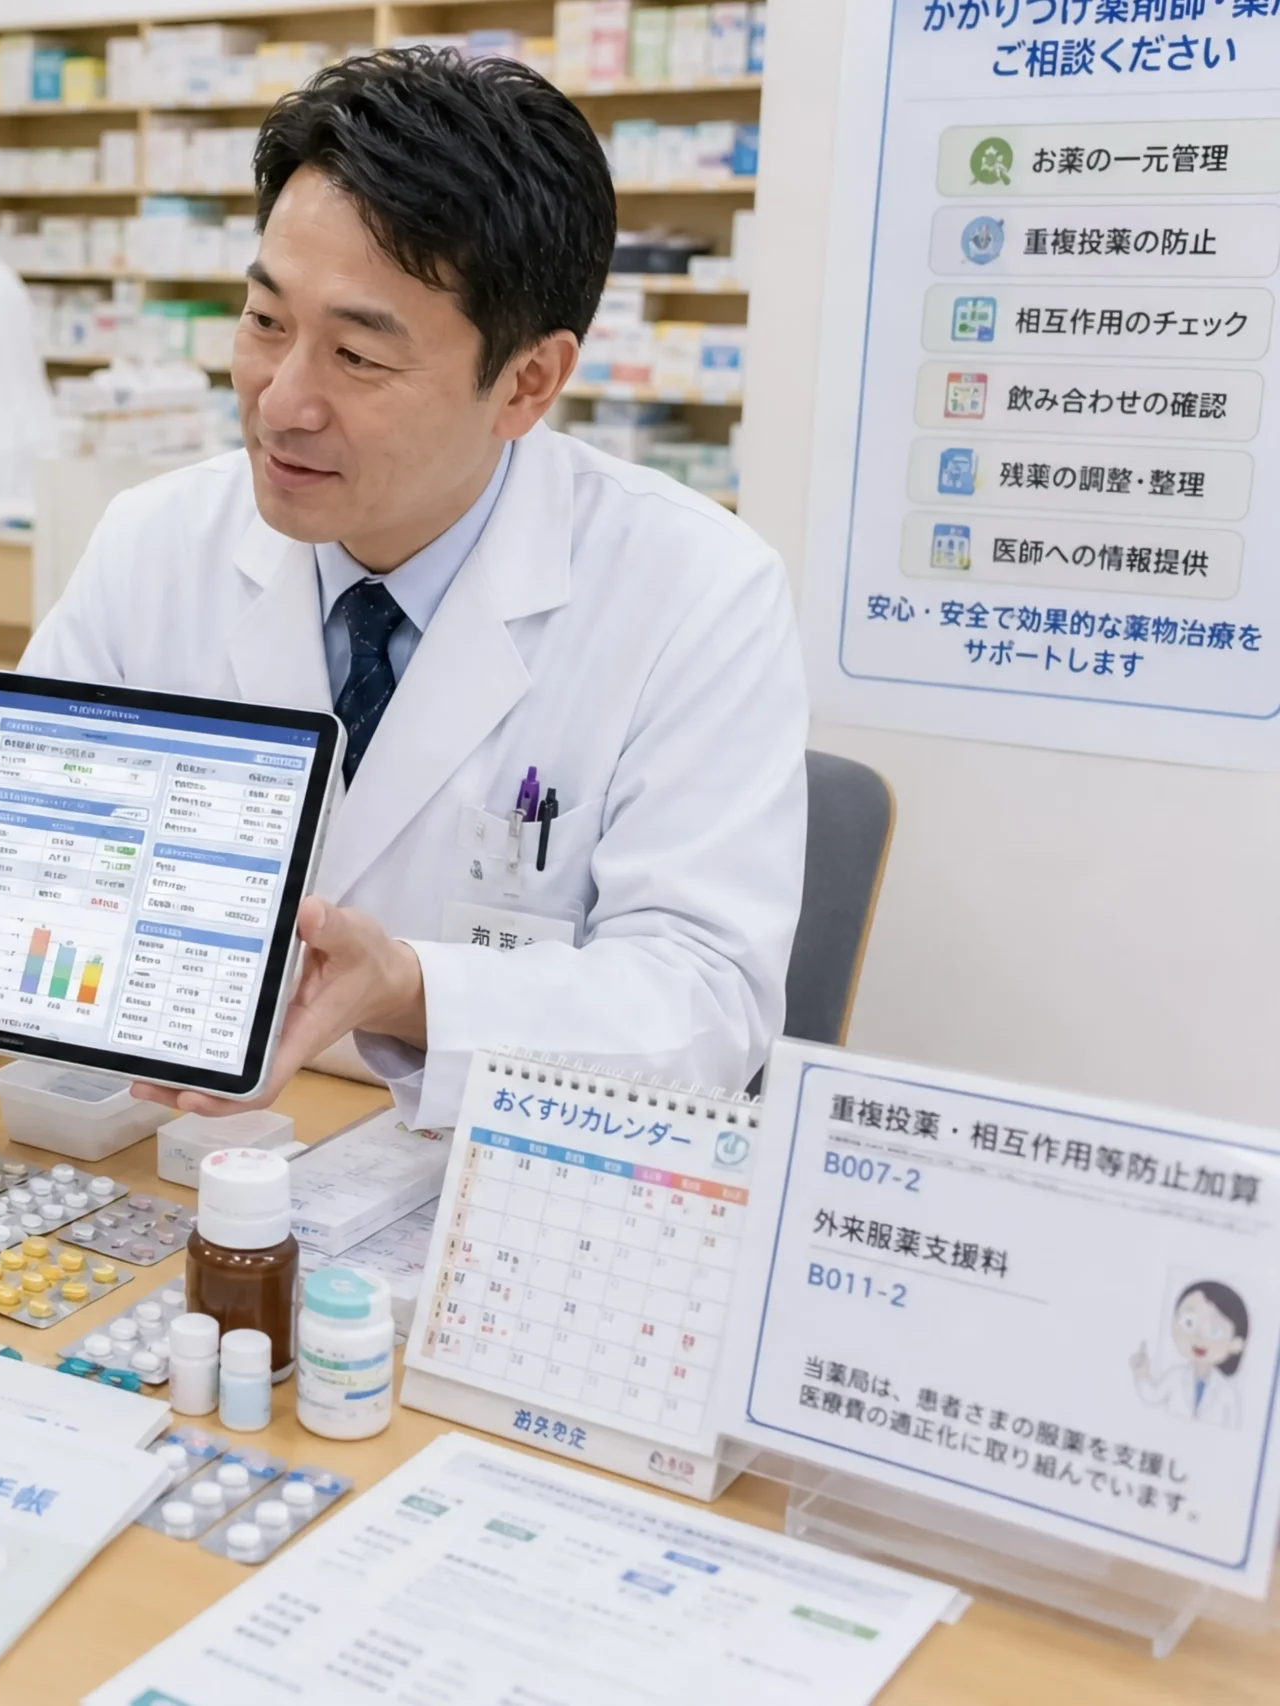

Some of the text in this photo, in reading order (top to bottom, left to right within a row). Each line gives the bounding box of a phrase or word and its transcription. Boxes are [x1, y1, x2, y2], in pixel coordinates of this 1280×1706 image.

[923, 0, 1280, 31] かかりつけ薬剤師・
[992, 34, 1237, 78] ご相談ください
[1031, 143, 1229, 175] お薬の一元管理
[1023, 227, 1218, 257] 重複投薬の防止
[1015, 307, 1249, 337] 相互作用のチェック
[1007, 385, 1228, 420] 飲み合わせの確認
[999, 461, 1206, 498] 残薬の調整・整理
[992, 538, 1210, 578] 医師への情報提供
[867, 594, 1263, 653] 安心・安全で効果的な薬物治療を
[963, 638, 1145, 678] サポートします
[493, 1086, 692, 1149] おくすりカレンダー
[829, 1093, 1261, 1206] 重複投薬・相互作用等防止加算
[823, 1151, 921, 1193] B007-2
[812, 1207, 1009, 1279] 外来服薬支援料
[807, 1262, 908, 1308] B011-2
[799, 1384, 1201, 1523] 医療費の適正化に取り組んでいます。
